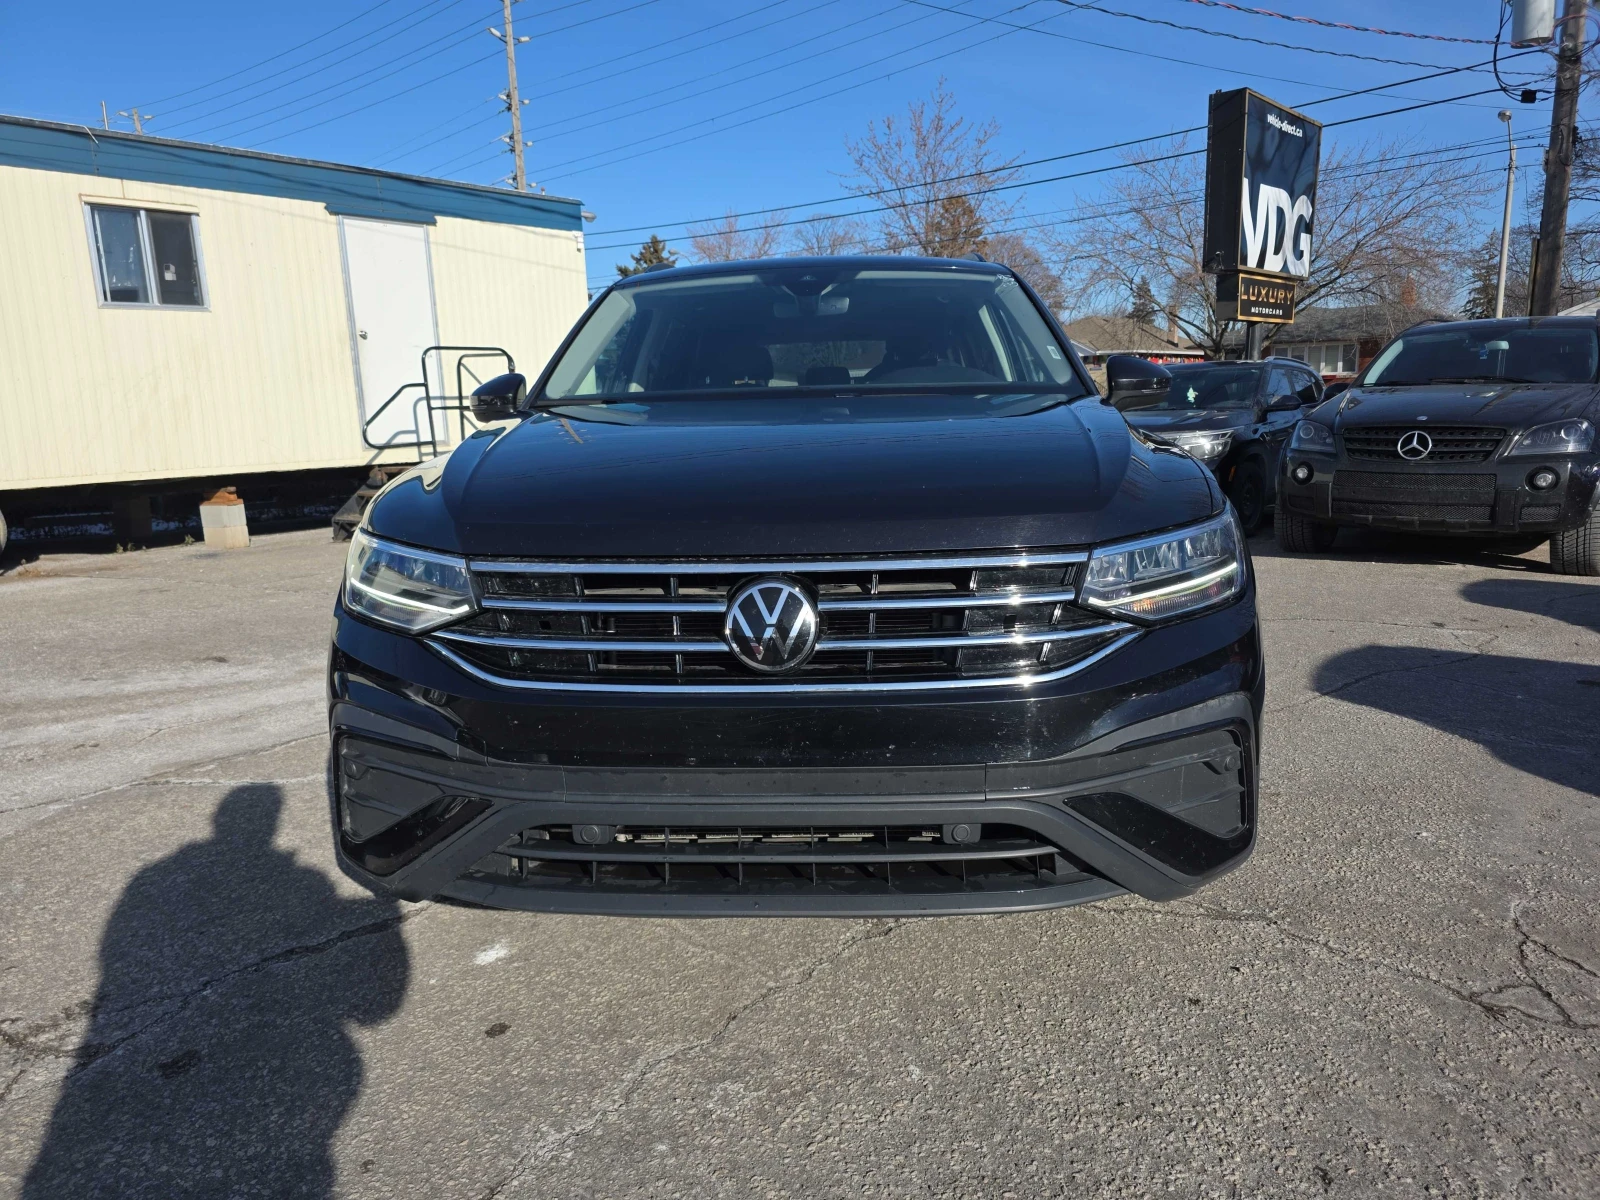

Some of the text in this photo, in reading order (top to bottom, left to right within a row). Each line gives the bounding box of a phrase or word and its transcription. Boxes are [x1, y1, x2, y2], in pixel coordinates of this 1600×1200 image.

[1242, 177, 1313, 278] VDG
[1241, 283, 1294, 305] LUXURY
[1251, 306, 1283, 316] MOTORCARS
